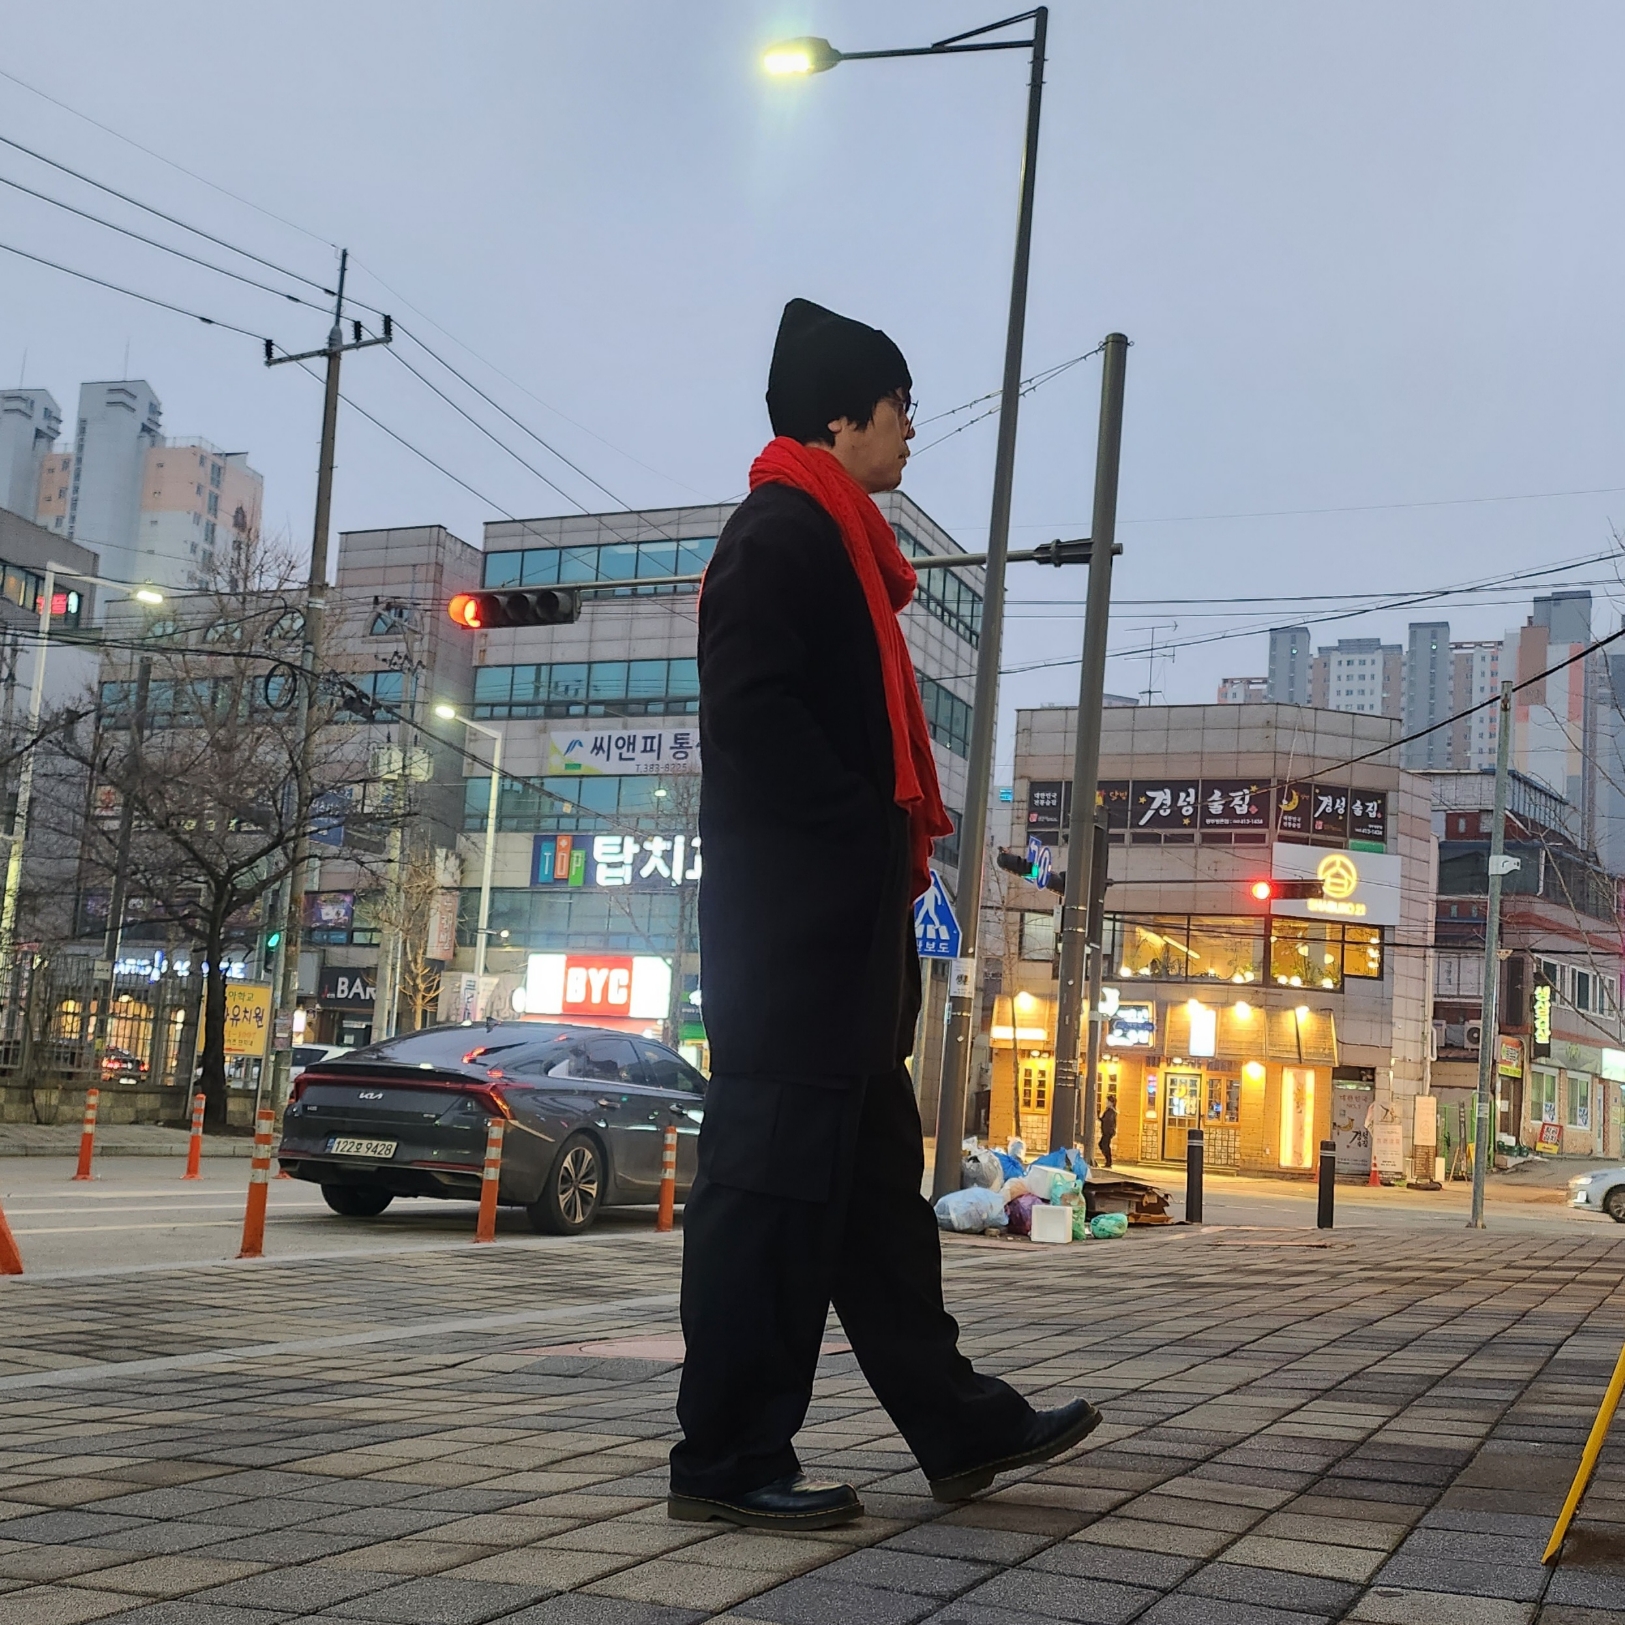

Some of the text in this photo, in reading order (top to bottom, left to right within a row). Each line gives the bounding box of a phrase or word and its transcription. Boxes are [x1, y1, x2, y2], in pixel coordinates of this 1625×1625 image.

[590, 732, 700, 762] 씨앤피 통
[1138, 788, 1250, 826] 경성 술집
[1314, 795, 1378, 818] 경성 술집
[544, 852, 583, 876] TOP
[226, 990, 255, 1003] 아학교
[565, 967, 630, 1005] BYC
[365, 1142, 393, 1156] 9428
